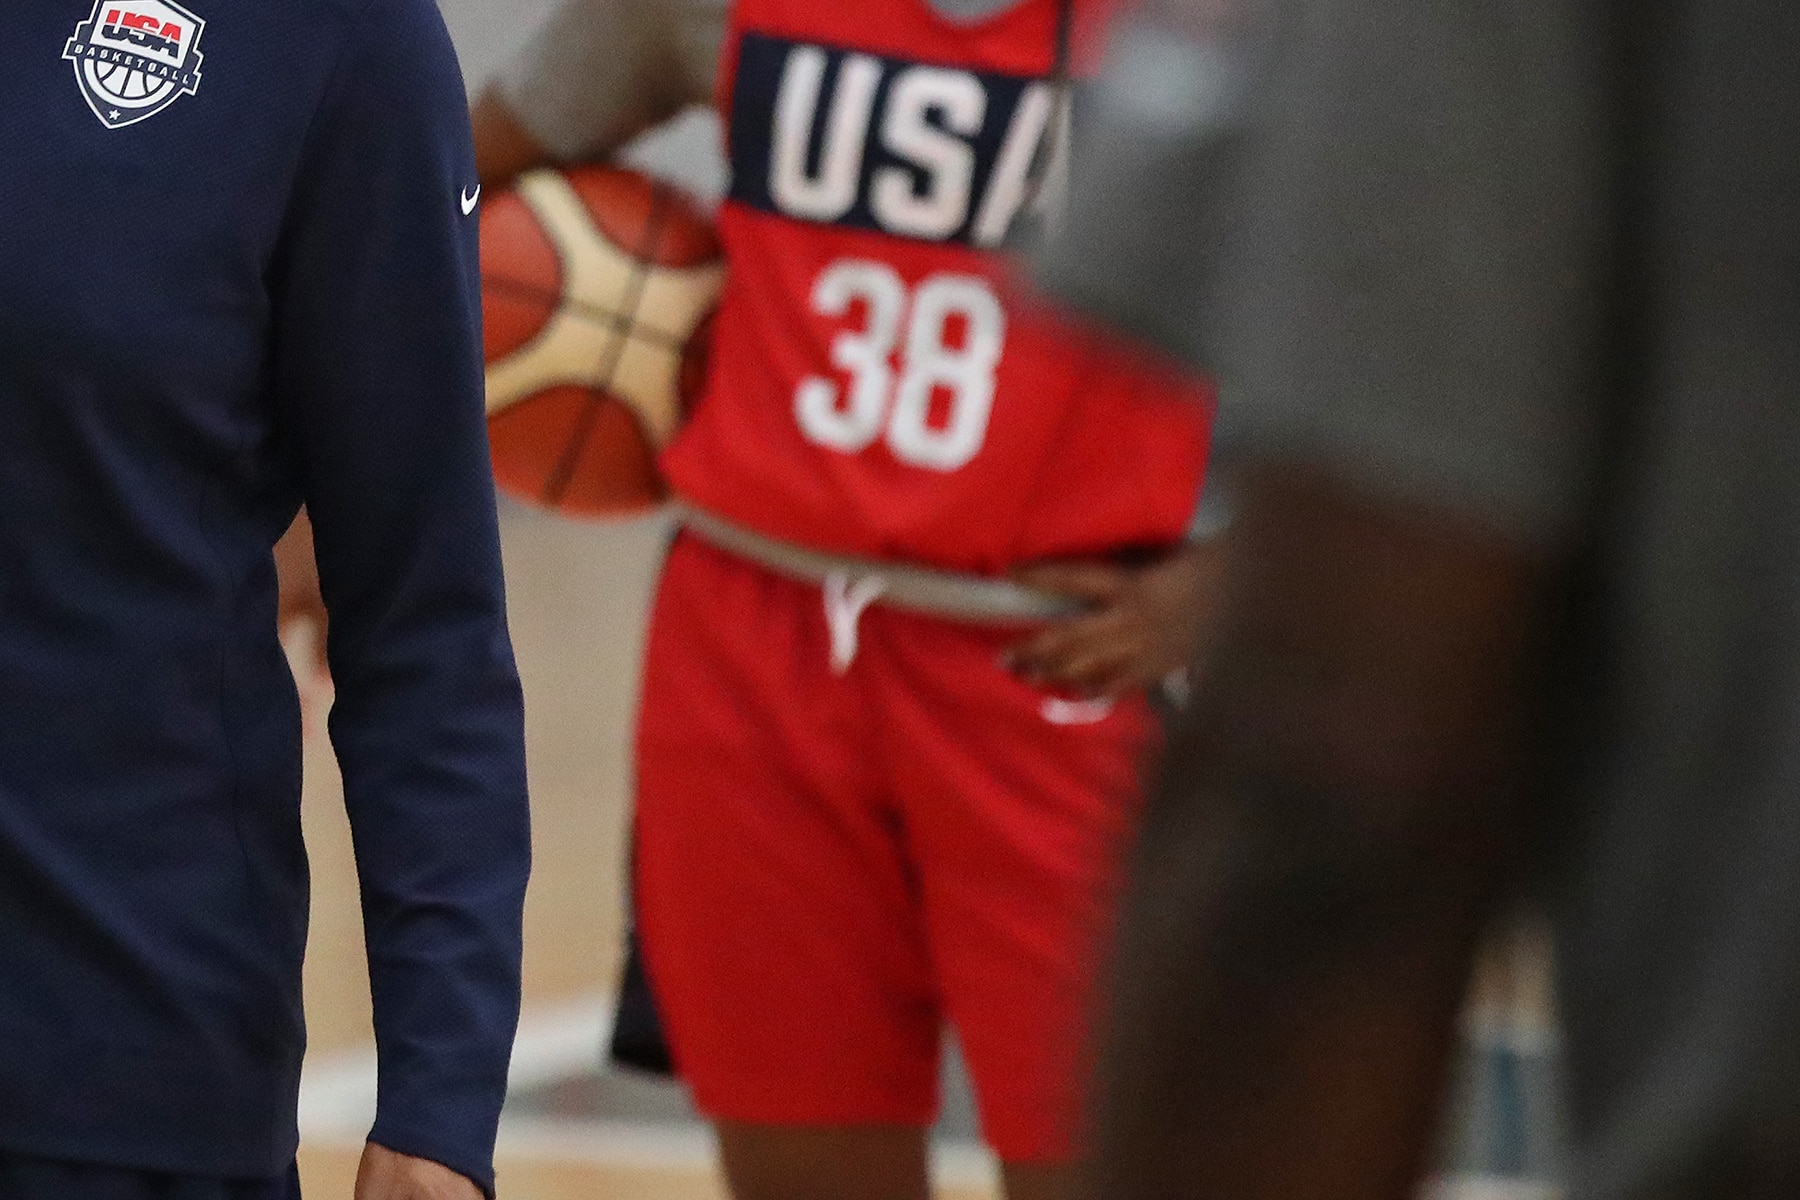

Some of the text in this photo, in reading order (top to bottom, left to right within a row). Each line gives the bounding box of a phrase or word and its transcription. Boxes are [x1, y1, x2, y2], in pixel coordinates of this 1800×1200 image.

[102, 9, 182, 59] USA
[74, 44, 190, 85] BASKETBALL
[795, 259, 1005, 472] 38
